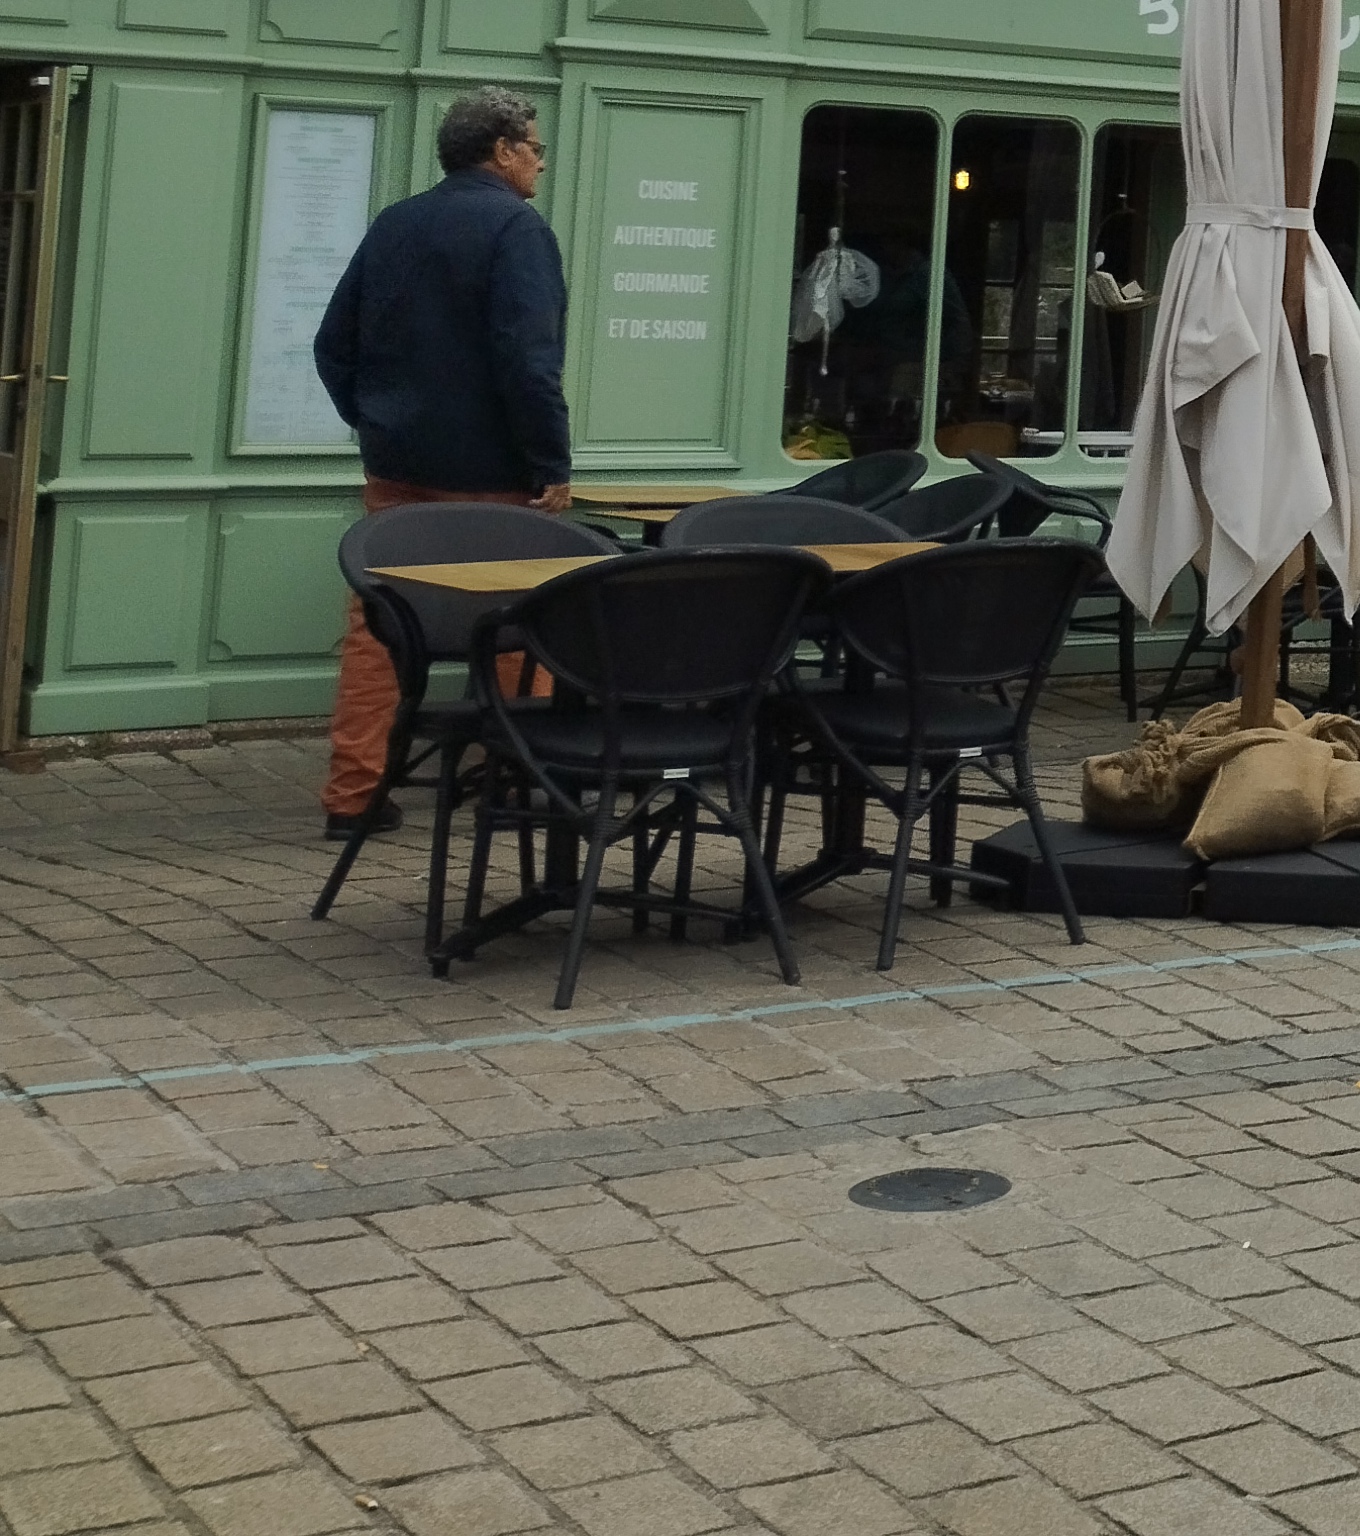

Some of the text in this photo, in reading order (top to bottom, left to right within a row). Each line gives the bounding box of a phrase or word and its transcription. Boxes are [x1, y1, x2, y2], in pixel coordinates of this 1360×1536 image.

[638, 179, 699, 201] CUISINE
[613, 225, 717, 248] AUTHENTIQUE
[613, 272, 710, 294] GOURMANDE
[608, 318, 708, 340] ET DE SAISON
